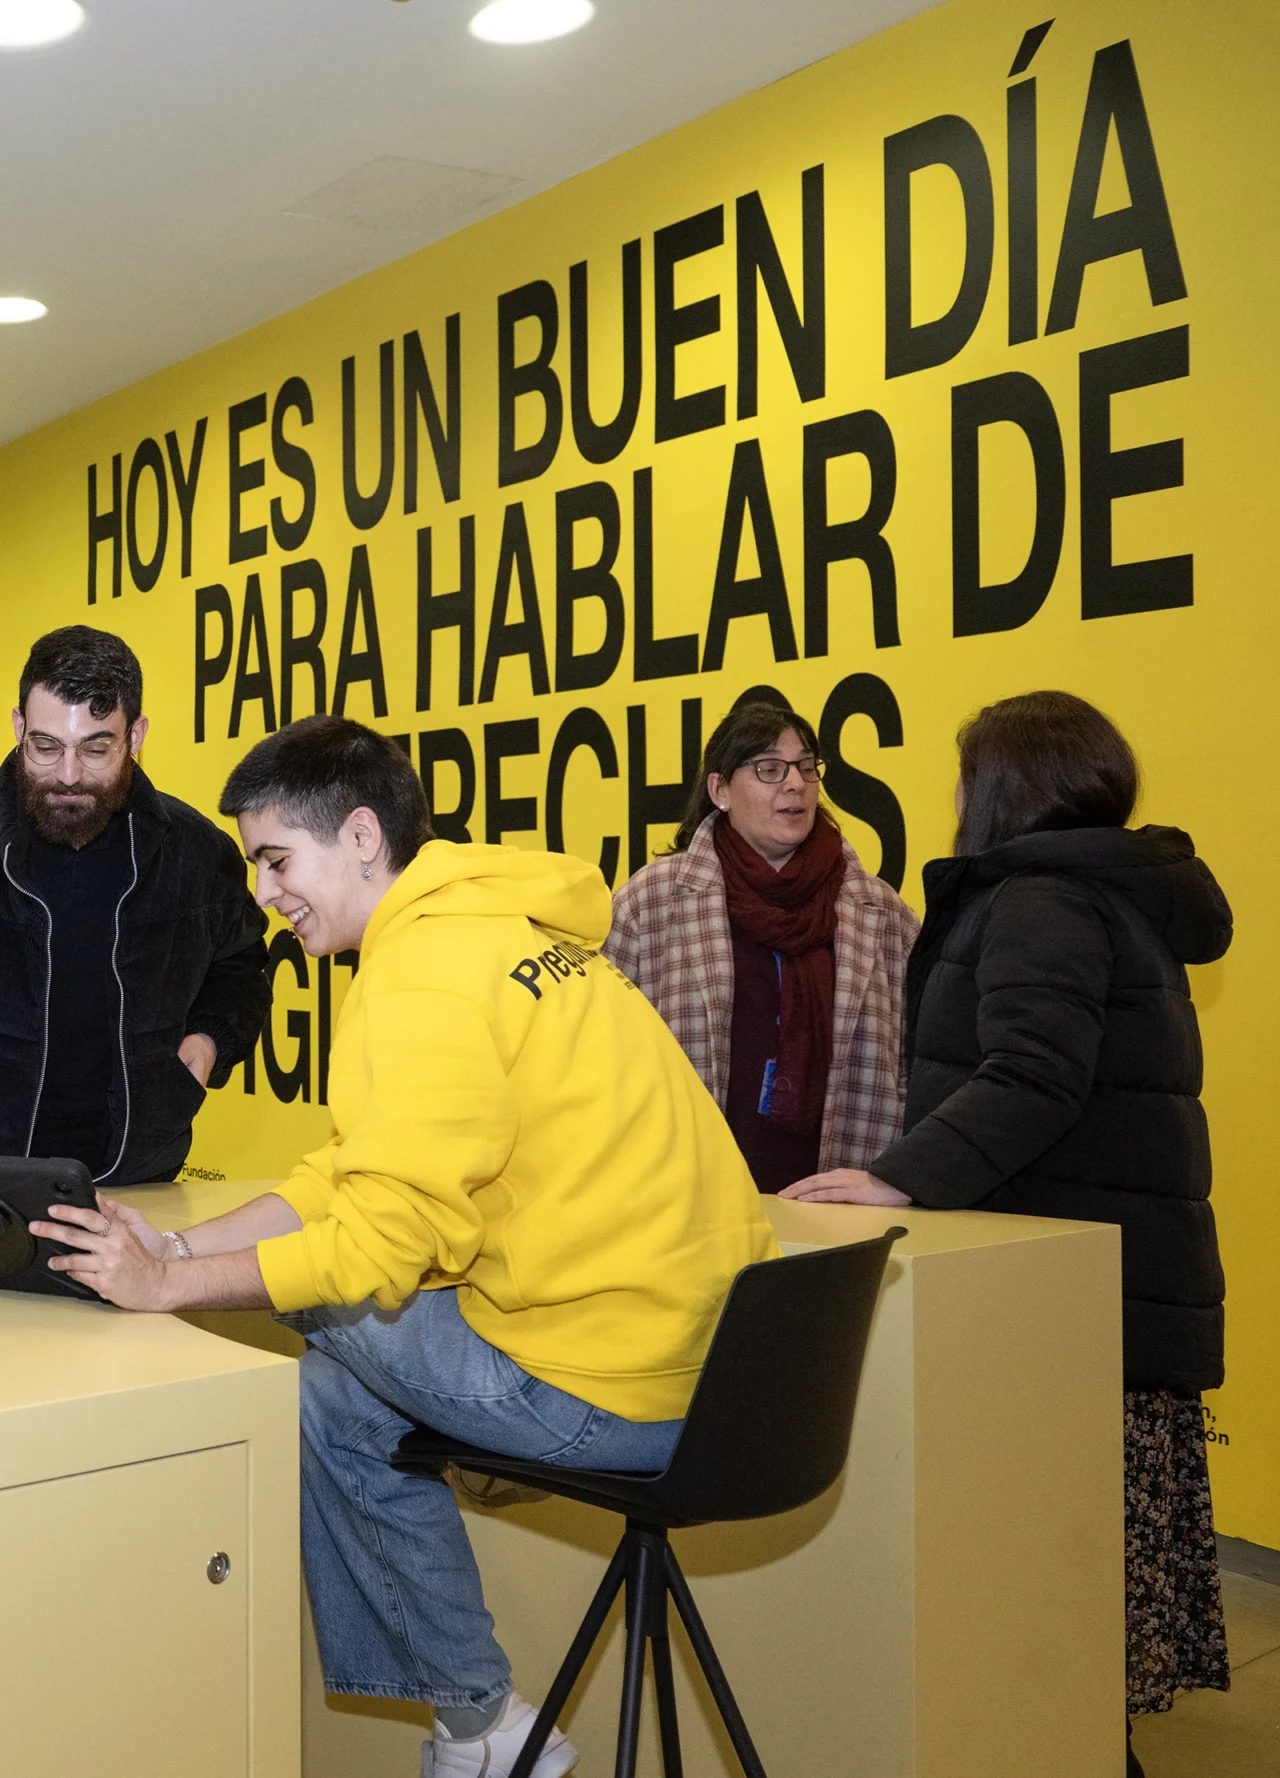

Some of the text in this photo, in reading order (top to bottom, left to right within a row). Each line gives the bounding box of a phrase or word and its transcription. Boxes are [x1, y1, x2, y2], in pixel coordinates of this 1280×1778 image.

[87, 17, 1189, 606] HOY ES UN BUEN DÍA
[194, 323, 1195, 744] PARA HABLAR DE
[389, 672, 908, 896] RECHS
[182, 1162, 226, 1181] Fundación
